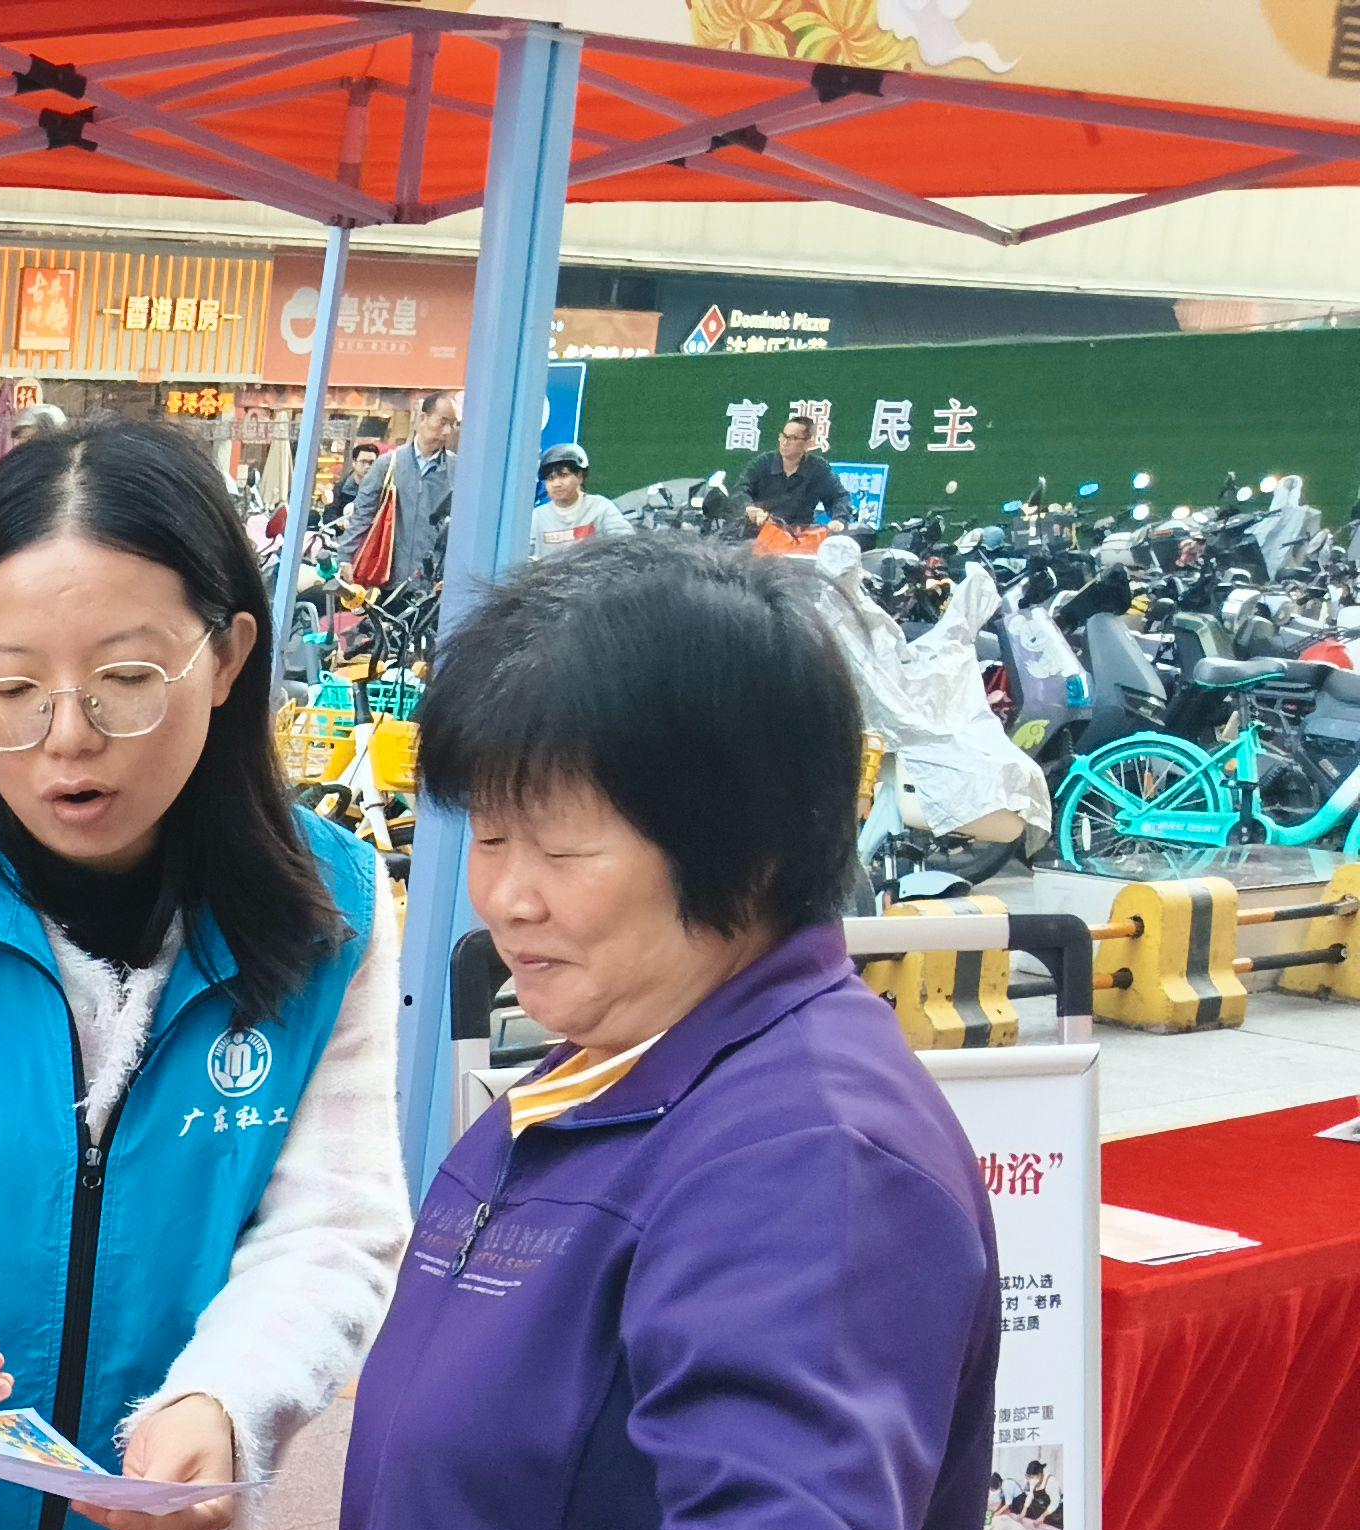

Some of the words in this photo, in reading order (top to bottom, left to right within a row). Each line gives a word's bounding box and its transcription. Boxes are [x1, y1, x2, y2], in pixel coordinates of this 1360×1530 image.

[337, 294, 417, 336] 粤饺皇
[730, 309, 790, 331] Domino's
[792, 312, 831, 332] Pizza
[868, 397, 978, 451] 民主
[178, 1105, 288, 1137] 广东社工
